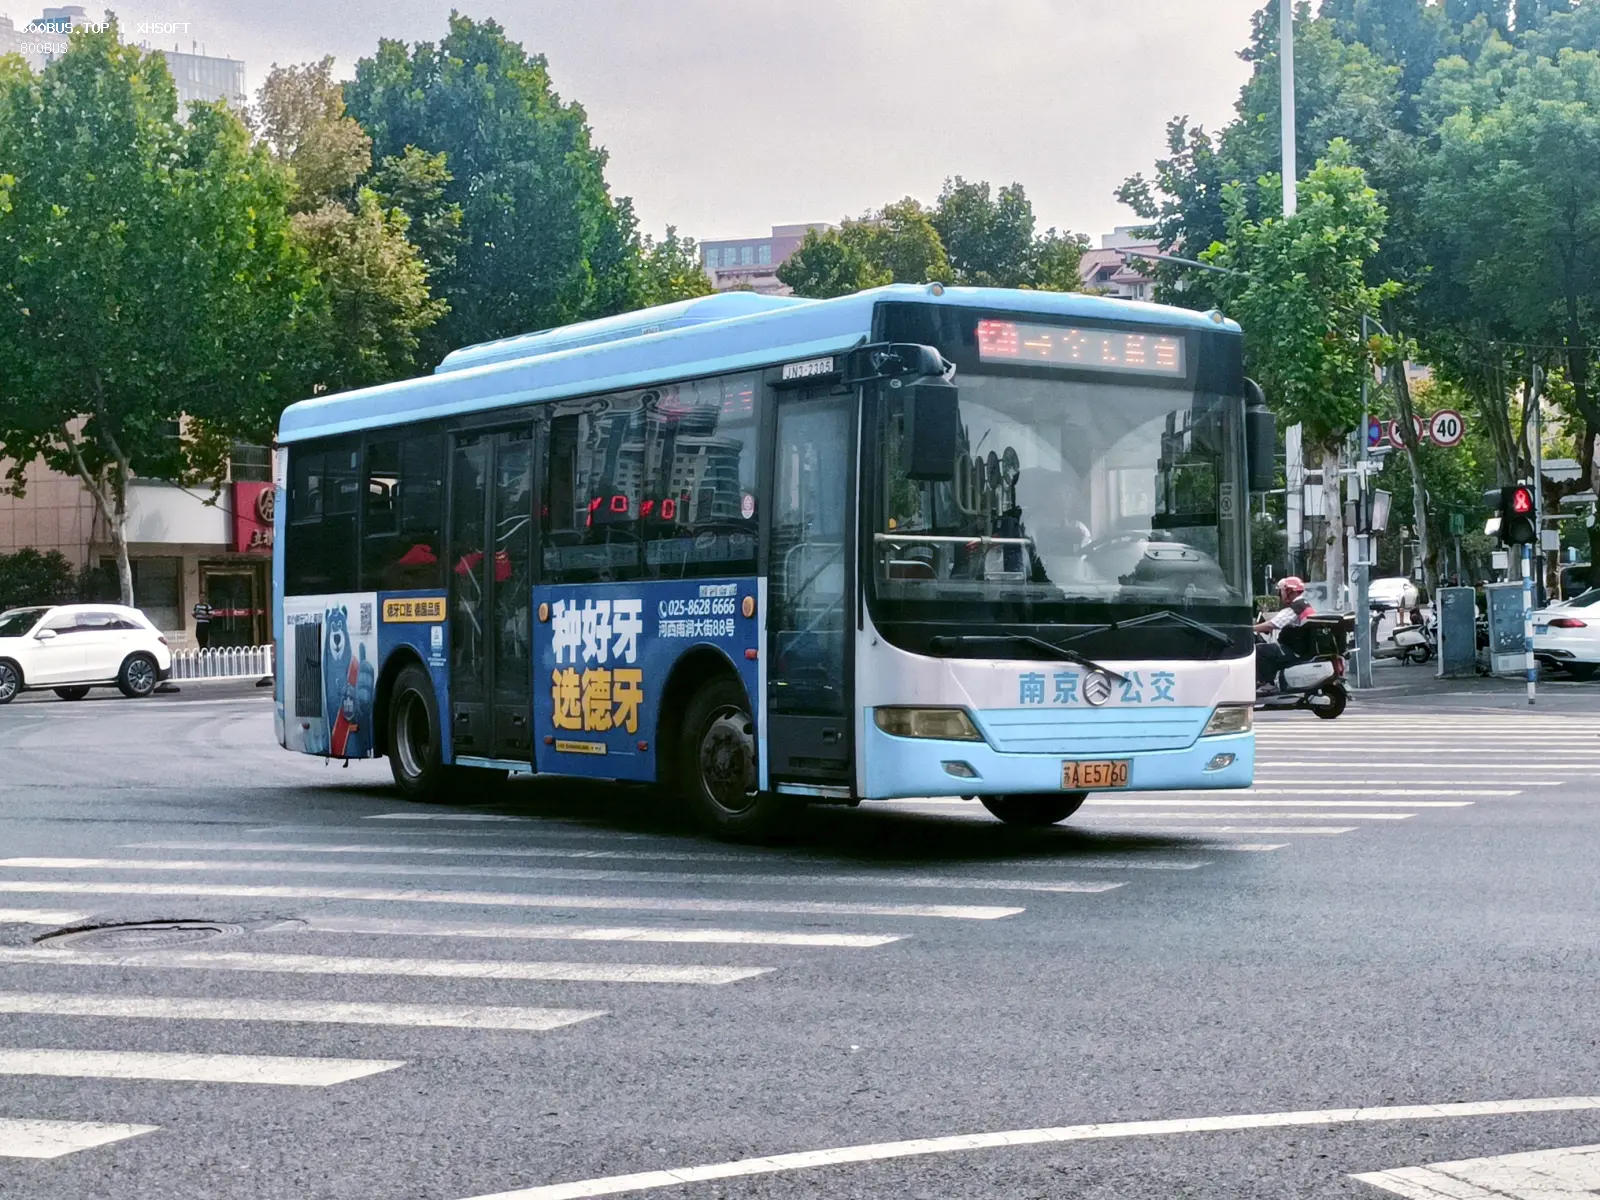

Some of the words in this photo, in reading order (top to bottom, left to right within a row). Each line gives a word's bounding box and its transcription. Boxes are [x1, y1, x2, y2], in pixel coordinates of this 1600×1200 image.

[1436, 418, 1457, 437] 40
[668, 599, 710, 616] 025-8628
[712, 598, 735, 615] 6666
[552, 599, 643, 664] 种好牙
[552, 667, 643, 733] 选德牙
[1019, 671, 1079, 704] 南京
[1118, 670, 1175, 703] 公交
